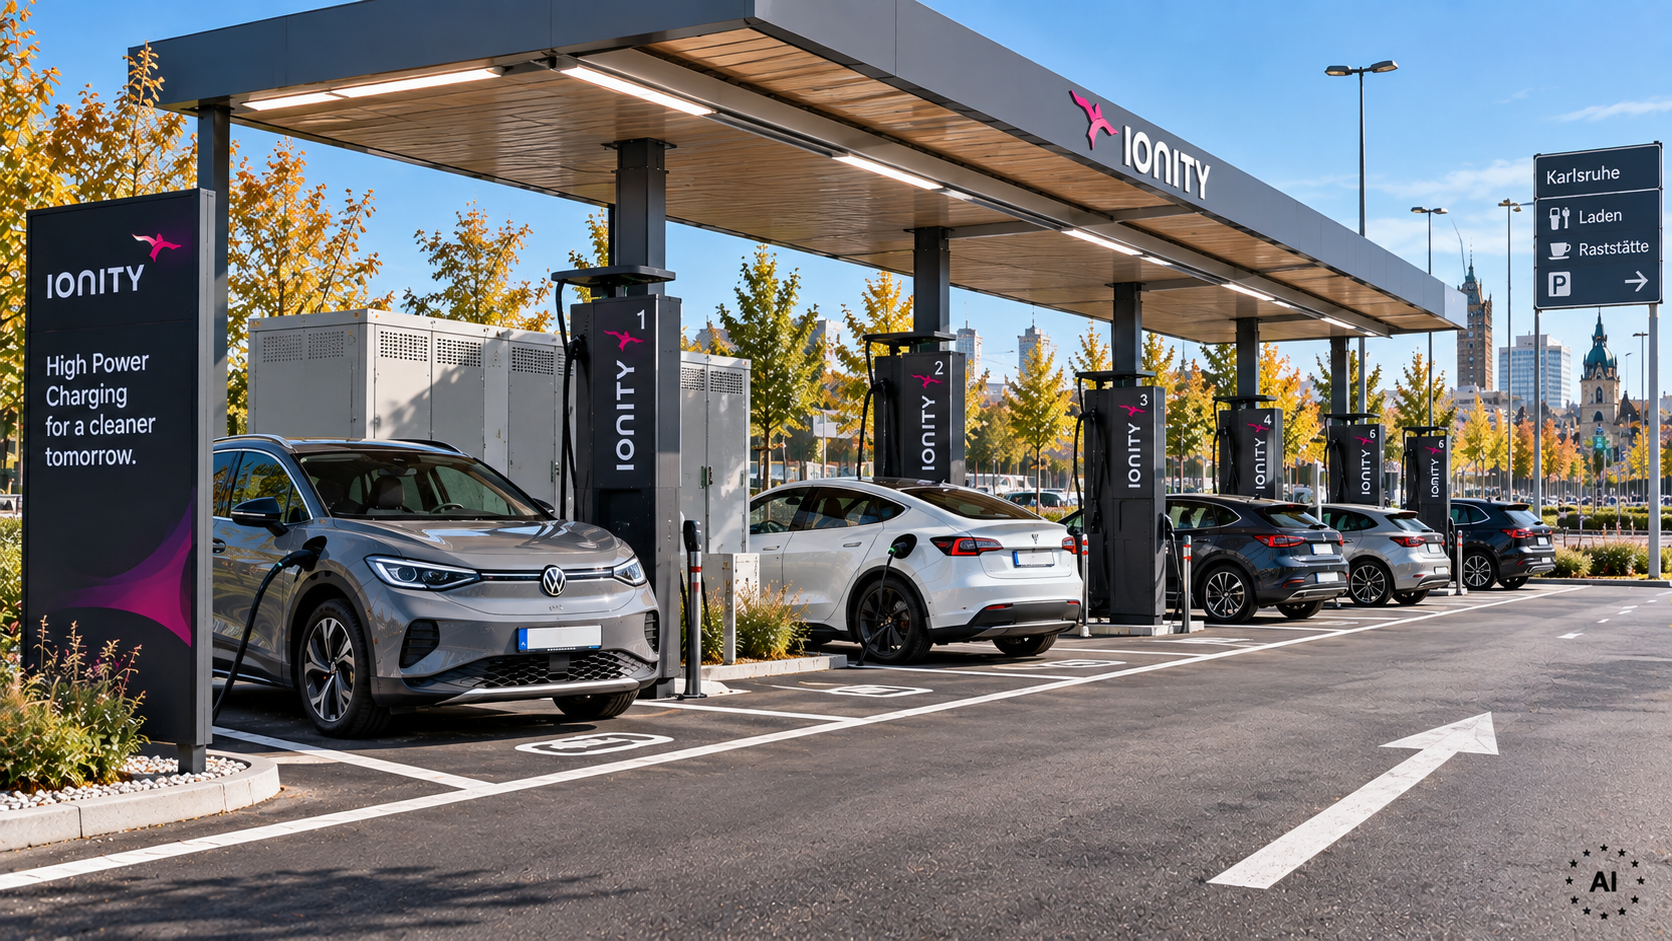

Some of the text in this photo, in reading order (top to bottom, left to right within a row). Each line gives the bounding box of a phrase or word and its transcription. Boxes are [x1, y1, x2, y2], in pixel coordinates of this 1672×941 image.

[1122, 125, 1211, 200] IONITY
[1546, 165, 1621, 185] Karlsruhe
[1579, 208, 1623, 224] Laden
[1579, 239, 1650, 257] Raststätte
[46, 264, 145, 299] IONITY
[1553, 275, 1567, 294] P
[636, 309, 645, 330] 1
[46, 352, 150, 381] High Power
[934, 360, 944, 376] 2
[46, 382, 128, 410] Charging
[1139, 393, 1148, 407] 3
[45, 413, 156, 437] for a cleaner
[615, 359, 635, 471] IONITY
[1263, 414, 1272, 425] 4
[921, 395, 936, 471] IONITY
[1438, 439, 1445, 449] 6
[45, 447, 137, 467] tomorrow.
[1127, 422, 1141, 488] IONITY
[1254, 437, 1266, 490] IONITY
[1361, 449, 1371, 495] IONITY
